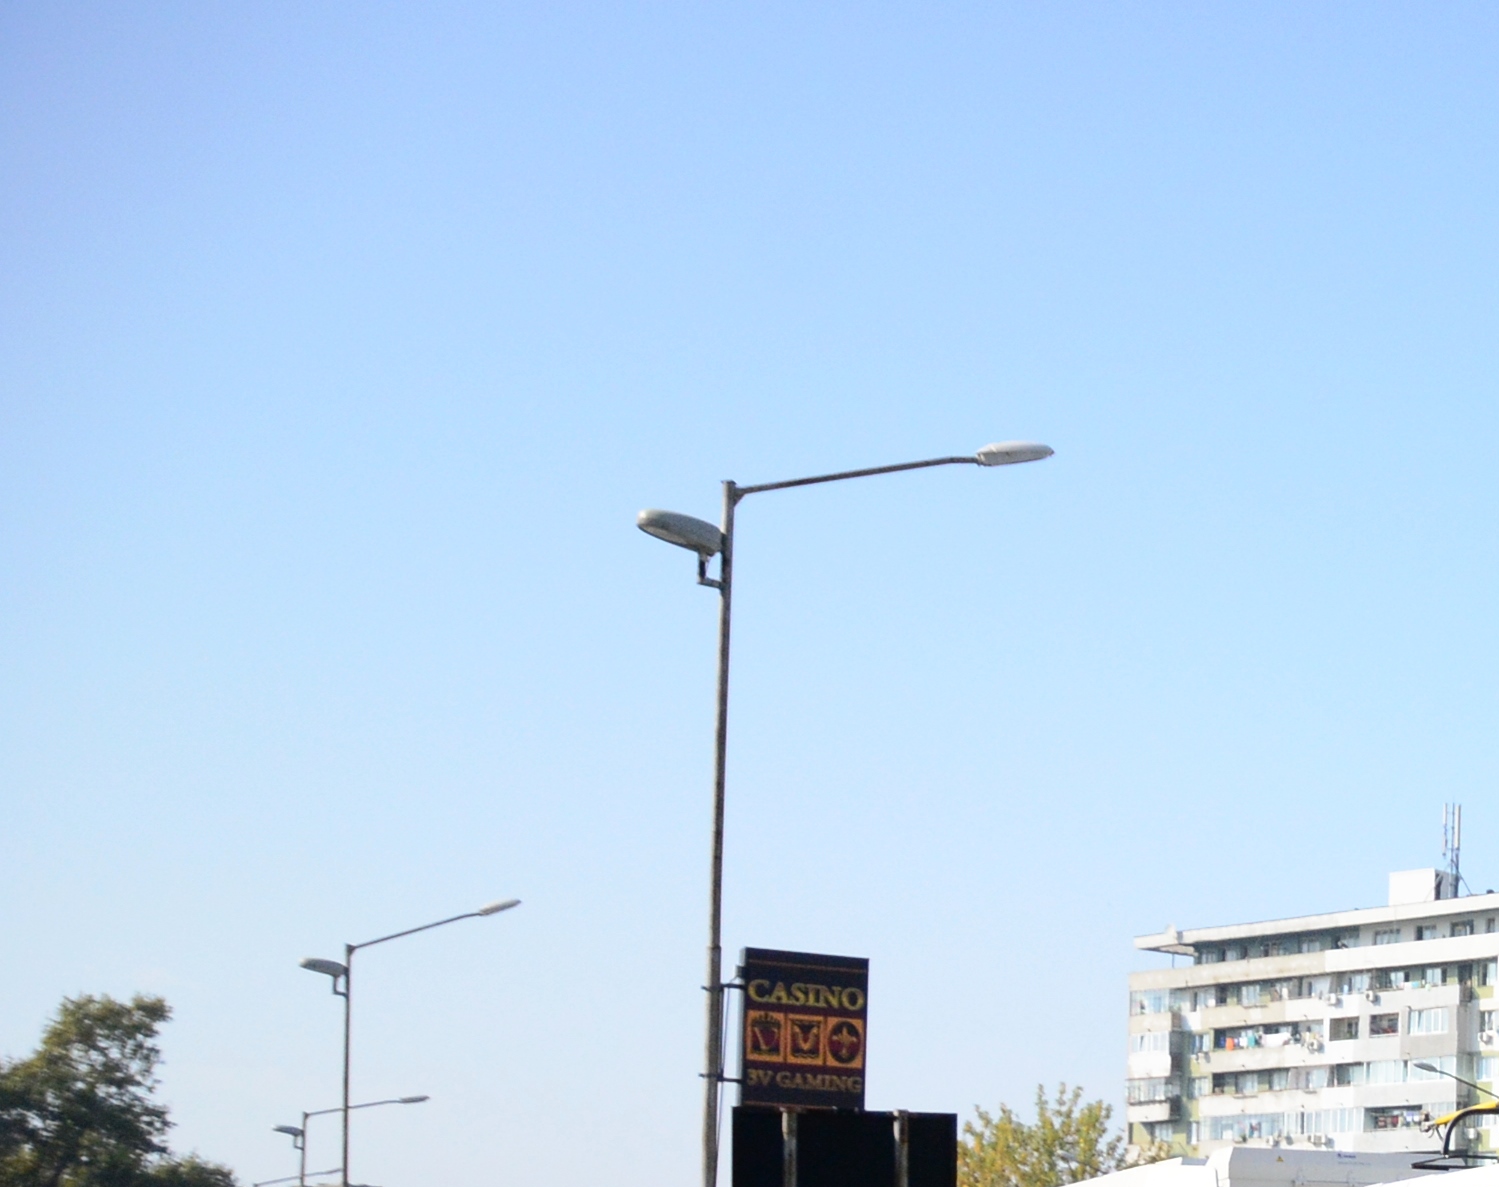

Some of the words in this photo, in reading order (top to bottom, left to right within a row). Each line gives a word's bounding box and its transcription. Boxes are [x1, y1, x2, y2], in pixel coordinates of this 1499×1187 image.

[747, 979, 865, 1011] CASINO
[746, 1067, 773, 1087] 3V
[775, 1070, 863, 1094] GAMING
